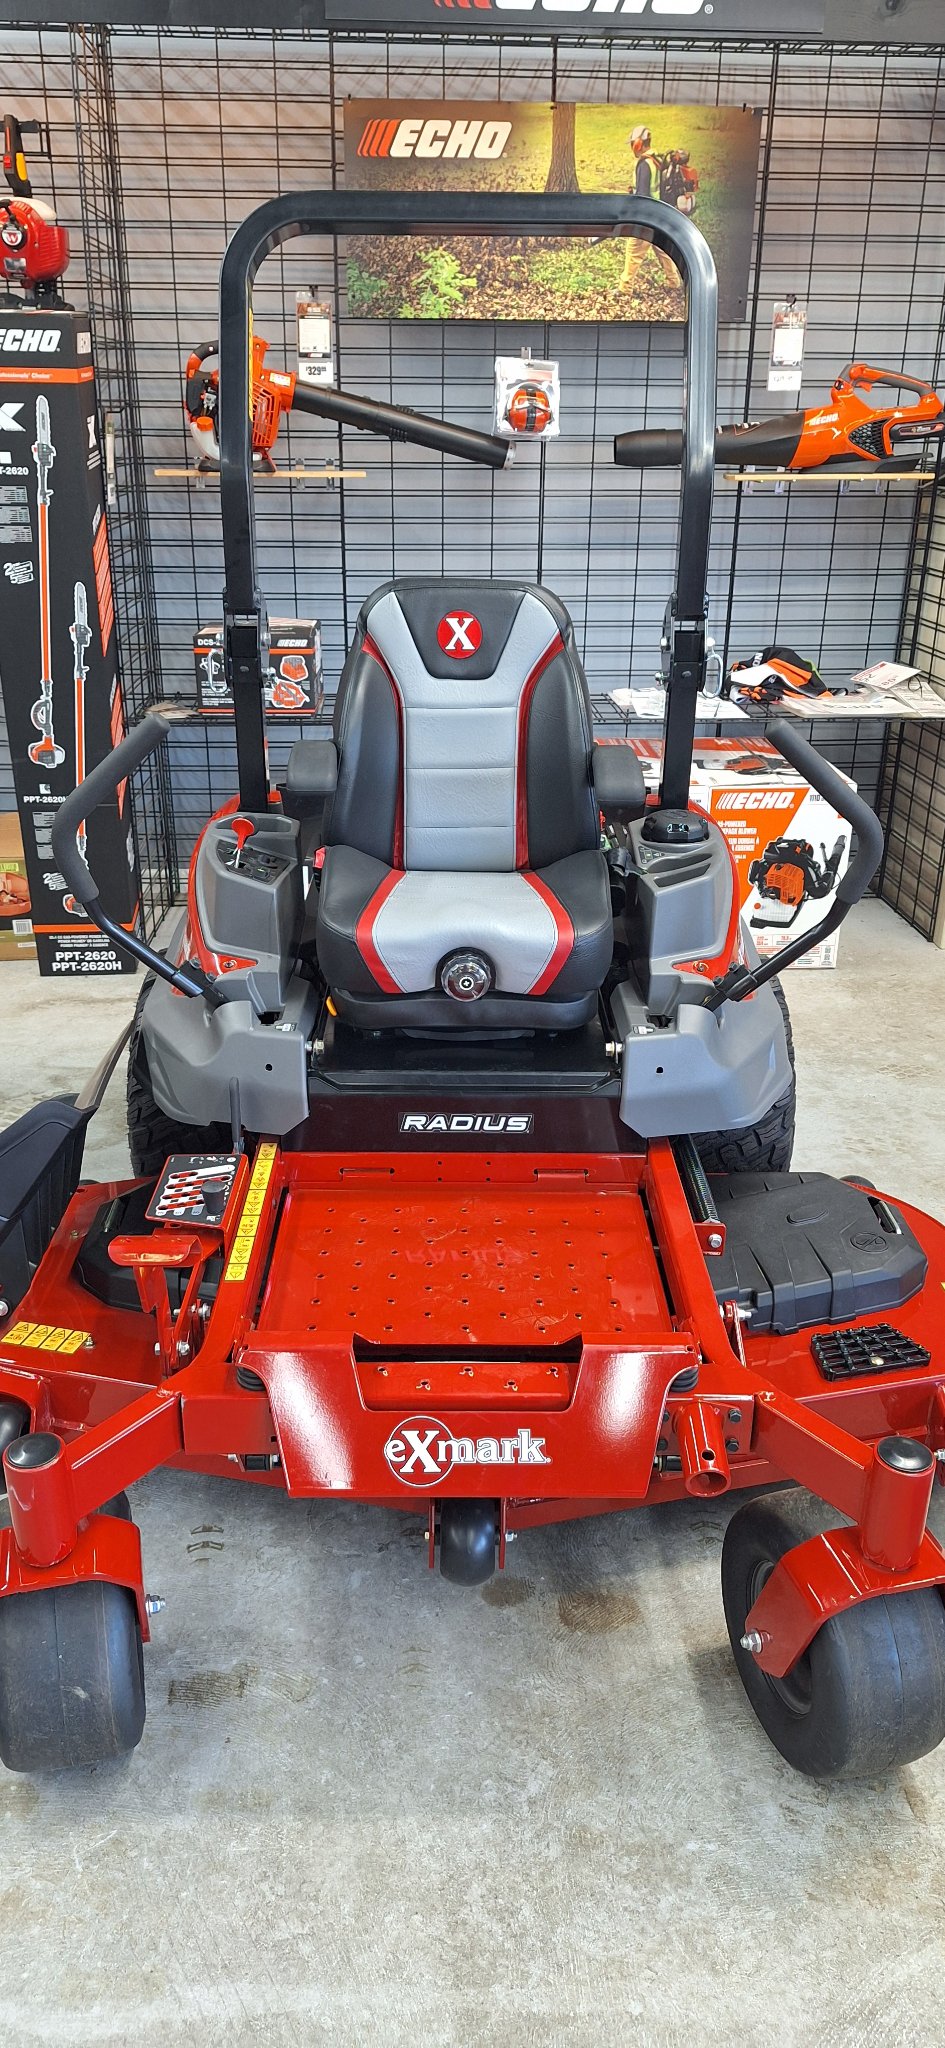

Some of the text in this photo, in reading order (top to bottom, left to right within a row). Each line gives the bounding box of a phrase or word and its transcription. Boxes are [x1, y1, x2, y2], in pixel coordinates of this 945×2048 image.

[389, 119, 512, 159] ECHO
[814, 413, 839, 426] ECHO
[284, 639, 308, 647] ECHO
[445, 617, 476, 651] X
[731, 791, 795, 810] ECHO
[55, 950, 117, 962] PPT-2620
[51, 961, 122, 972] PPT-2620H
[402, 1114, 531, 1132] RADIUS
[385, 1428, 549, 1474] eXmark
